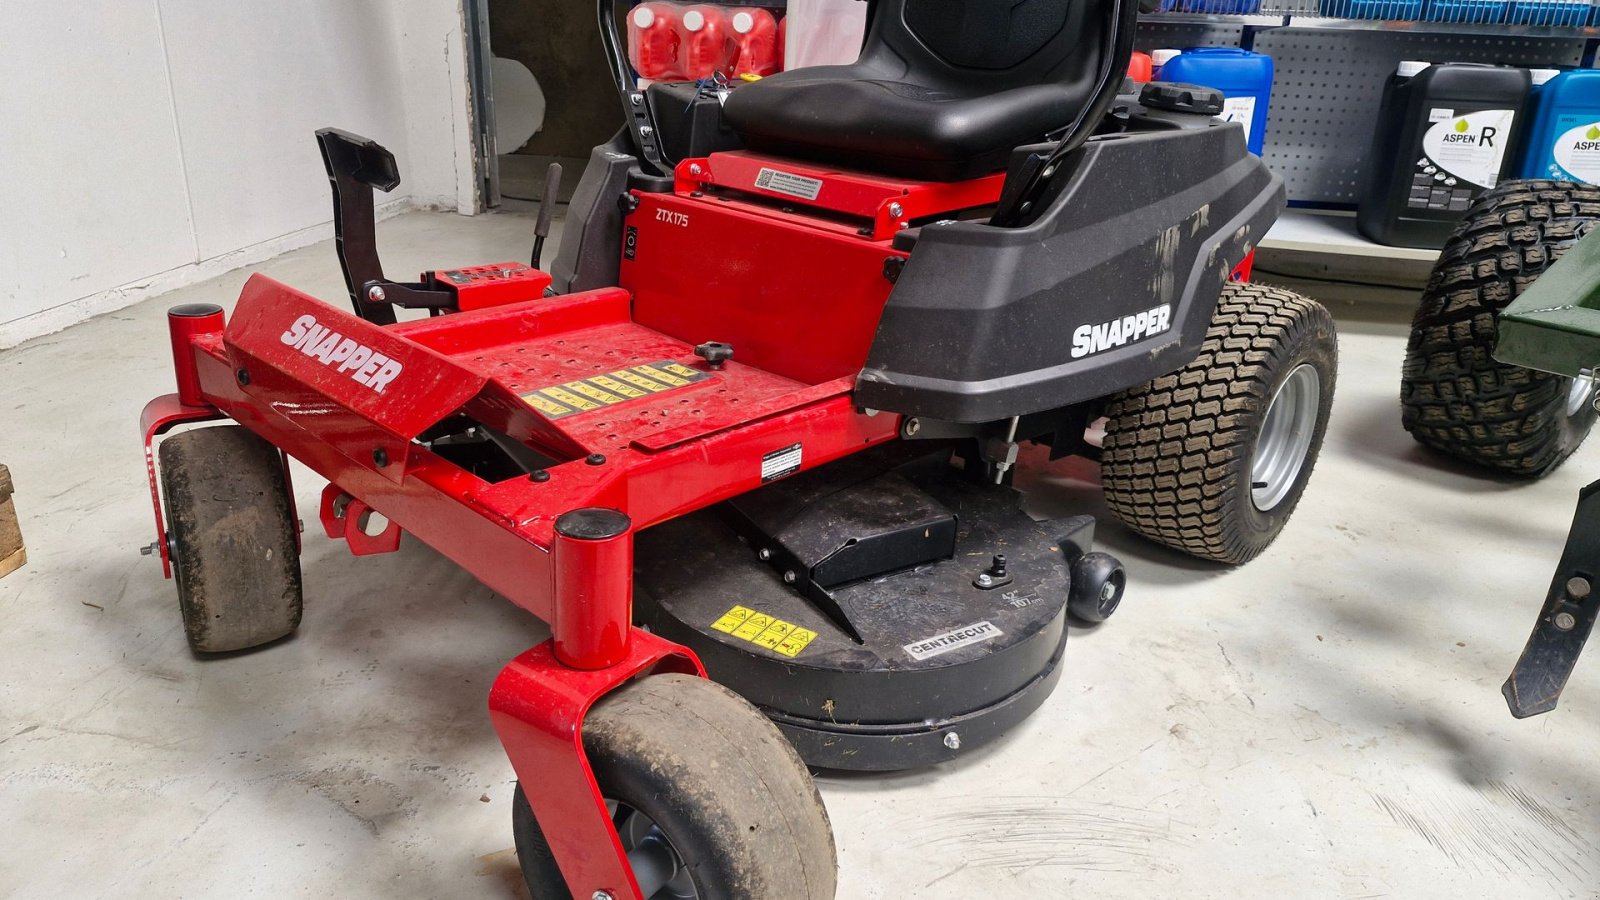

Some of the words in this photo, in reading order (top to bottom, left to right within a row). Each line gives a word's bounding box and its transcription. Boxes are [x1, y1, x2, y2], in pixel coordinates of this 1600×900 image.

[1443, 134, 1475, 143] ASPEN
[1479, 127, 1496, 147] R
[1071, 304, 1170, 358] SNAPPER
[280, 314, 403, 395] SNAPPER
[911, 624, 992, 654] CENTRECUT
